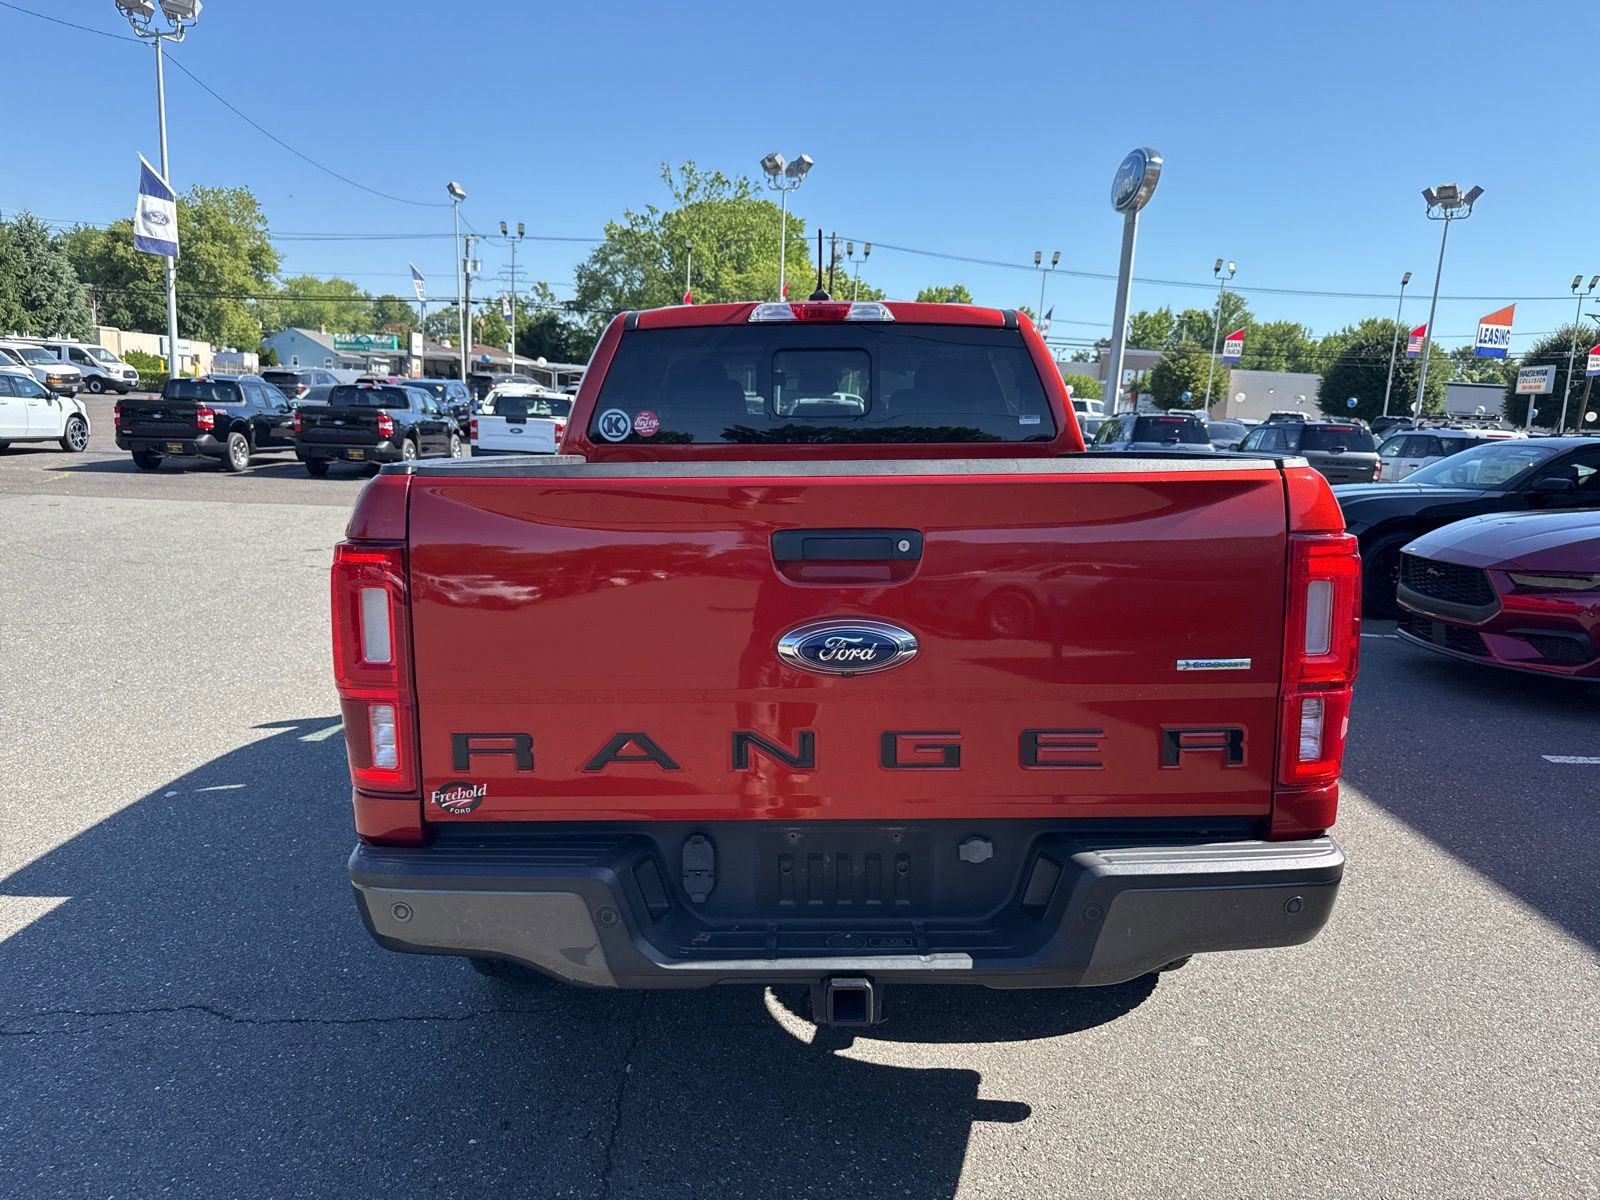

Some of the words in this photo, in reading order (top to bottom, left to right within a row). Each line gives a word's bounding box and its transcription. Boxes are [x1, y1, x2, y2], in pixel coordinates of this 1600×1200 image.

[1478, 327, 1511, 346] LEASING
[819, 636, 877, 660] Ford
[450, 726, 1248, 772] RANGER
[430, 783, 488, 804] Freehold
[449, 807, 471, 815] FORD
